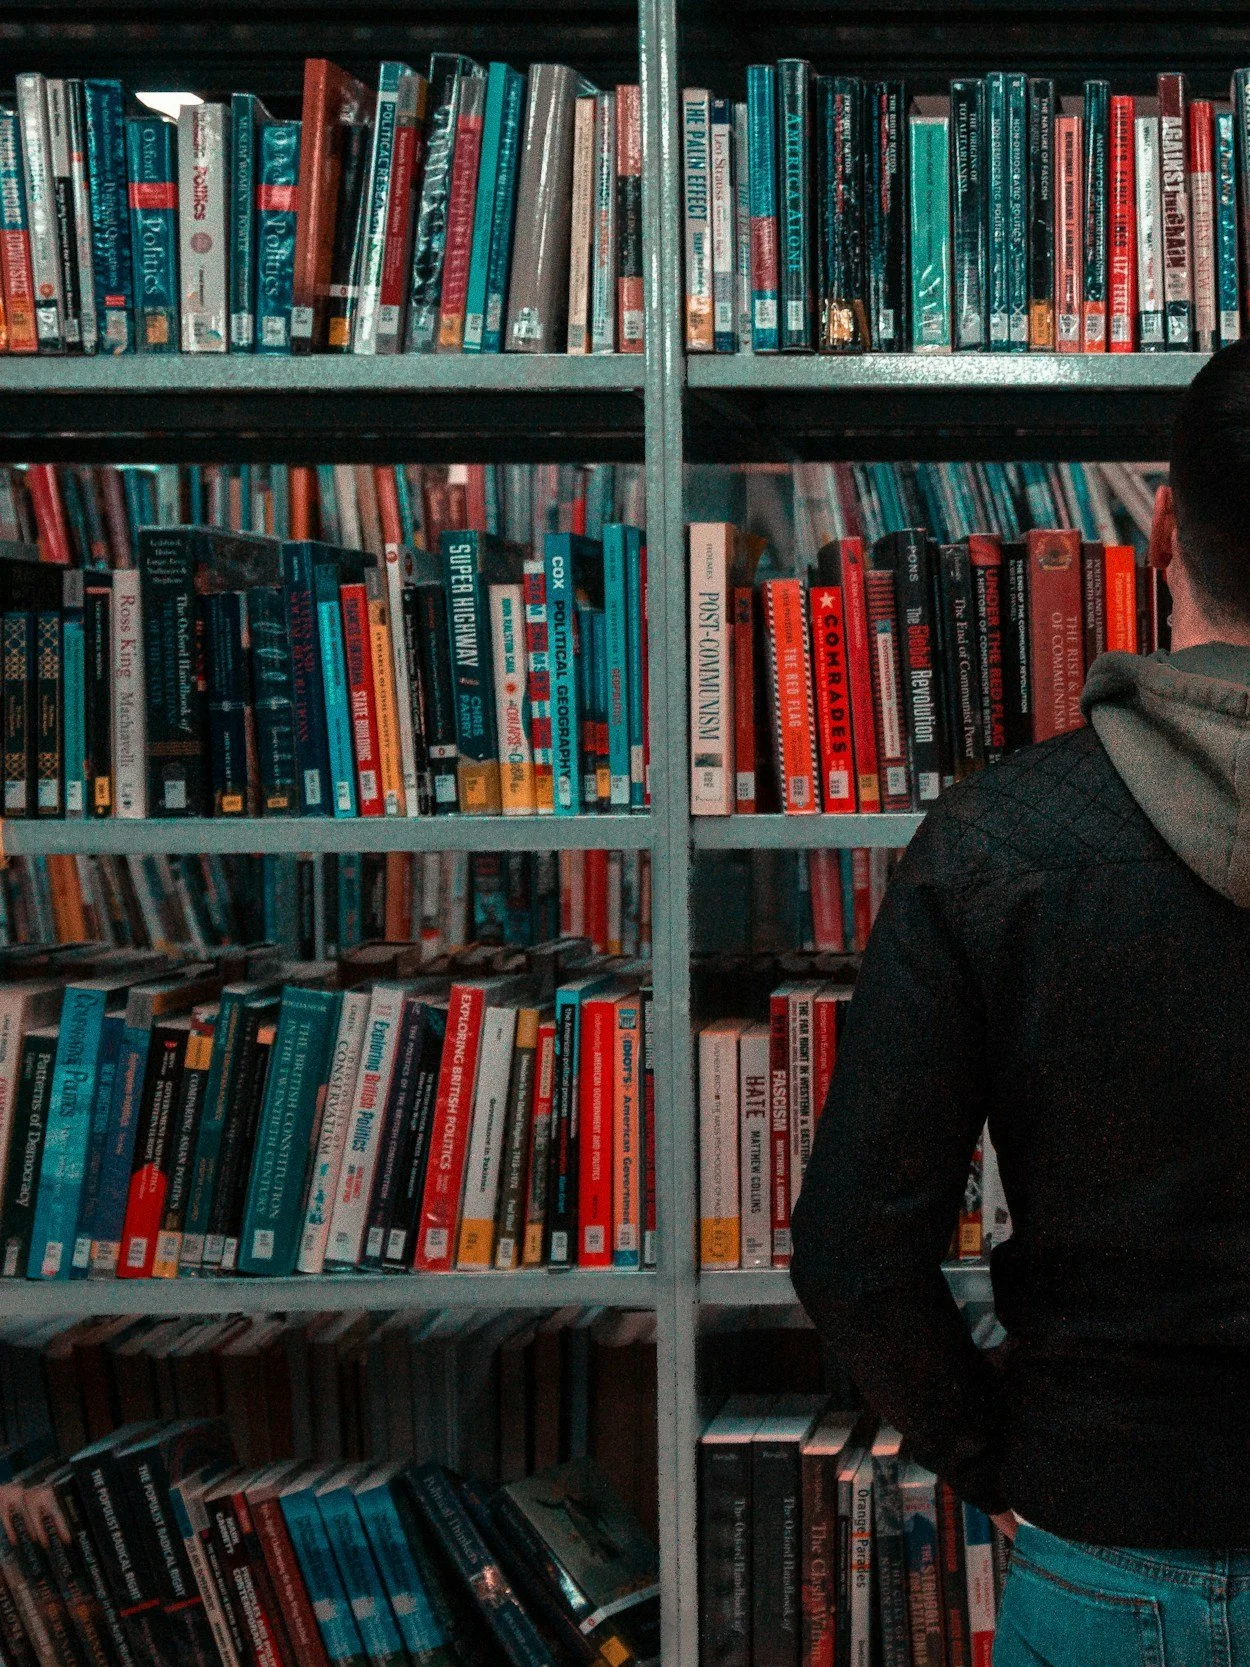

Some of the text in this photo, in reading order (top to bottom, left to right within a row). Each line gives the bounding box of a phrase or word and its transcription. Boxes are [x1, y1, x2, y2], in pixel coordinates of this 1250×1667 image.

[369, 103, 395, 234] POLITICAL RESEARCH
[686, 101, 707, 221] THE PALIN EFFECT
[713, 133, 725, 201] Leo Strauss
[958, 102, 968, 192] TOTALITARIANISM
[969, 112, 978, 182] THE ORIGINS OF
[1041, 116, 1049, 149] NATURE
[1041, 152, 1049, 163] OF
[1162, 116, 1183, 194] AGAINST
[140, 128, 165, 294] Oxford Politics
[1041, 165, 1049, 200] FASCISM
[3, 178, 29, 295] MOORE DOWNSIZE
[1167, 213, 1186, 268] GRAIN
[449, 544, 479, 667] SUPER HIGHWAY
[907, 545, 918, 582] PONS
[119, 639, 135, 677] King
[120, 595, 135, 632] Ross
[906, 607, 922, 624] The
[1065, 617, 1079, 644] THE
[177, 594, 192, 732] The Oxford Handbook of
[552, 556, 572, 777] COX POLITICAL GEOGRAPHY
[699, 592, 721, 741] POST-COMMUNISM
[784, 648, 801, 727] THE RED FLAG
[824, 614, 847, 754] COMRADES
[910, 670, 933, 743] Revolution
[955, 597, 976, 758] The End of Communist Power
[1050, 612, 1066, 729] OF COMMUNISM
[1066, 649, 1079, 678] RISE
[353, 691, 371, 761] STATE BUILDING
[460, 694, 472, 739] PARRY
[471, 695, 483, 736] CHRIS
[1068, 697, 1080, 725] FALL
[269, 1023, 310, 1219] THE BRITISH CONSTITUTION
[320, 1040, 349, 1155] CONSERVATISM
[352, 1021, 388, 1153] Exploring British Politics
[439, 995, 472, 1170] EXPLORING BRITISH POLITICS
[772, 1070, 787, 1131] FASCISM
[16, 1053, 51, 1208] Patterns of Democracy
[745, 1075, 764, 1213] HATE MATTHEW COLLINS
[137, 1464, 185, 1597] THE POPULIST RADICAL RIGHT
[783, 1496, 795, 1618] The Oxford Handbook
[856, 1488, 868, 1588] Orange Parades
